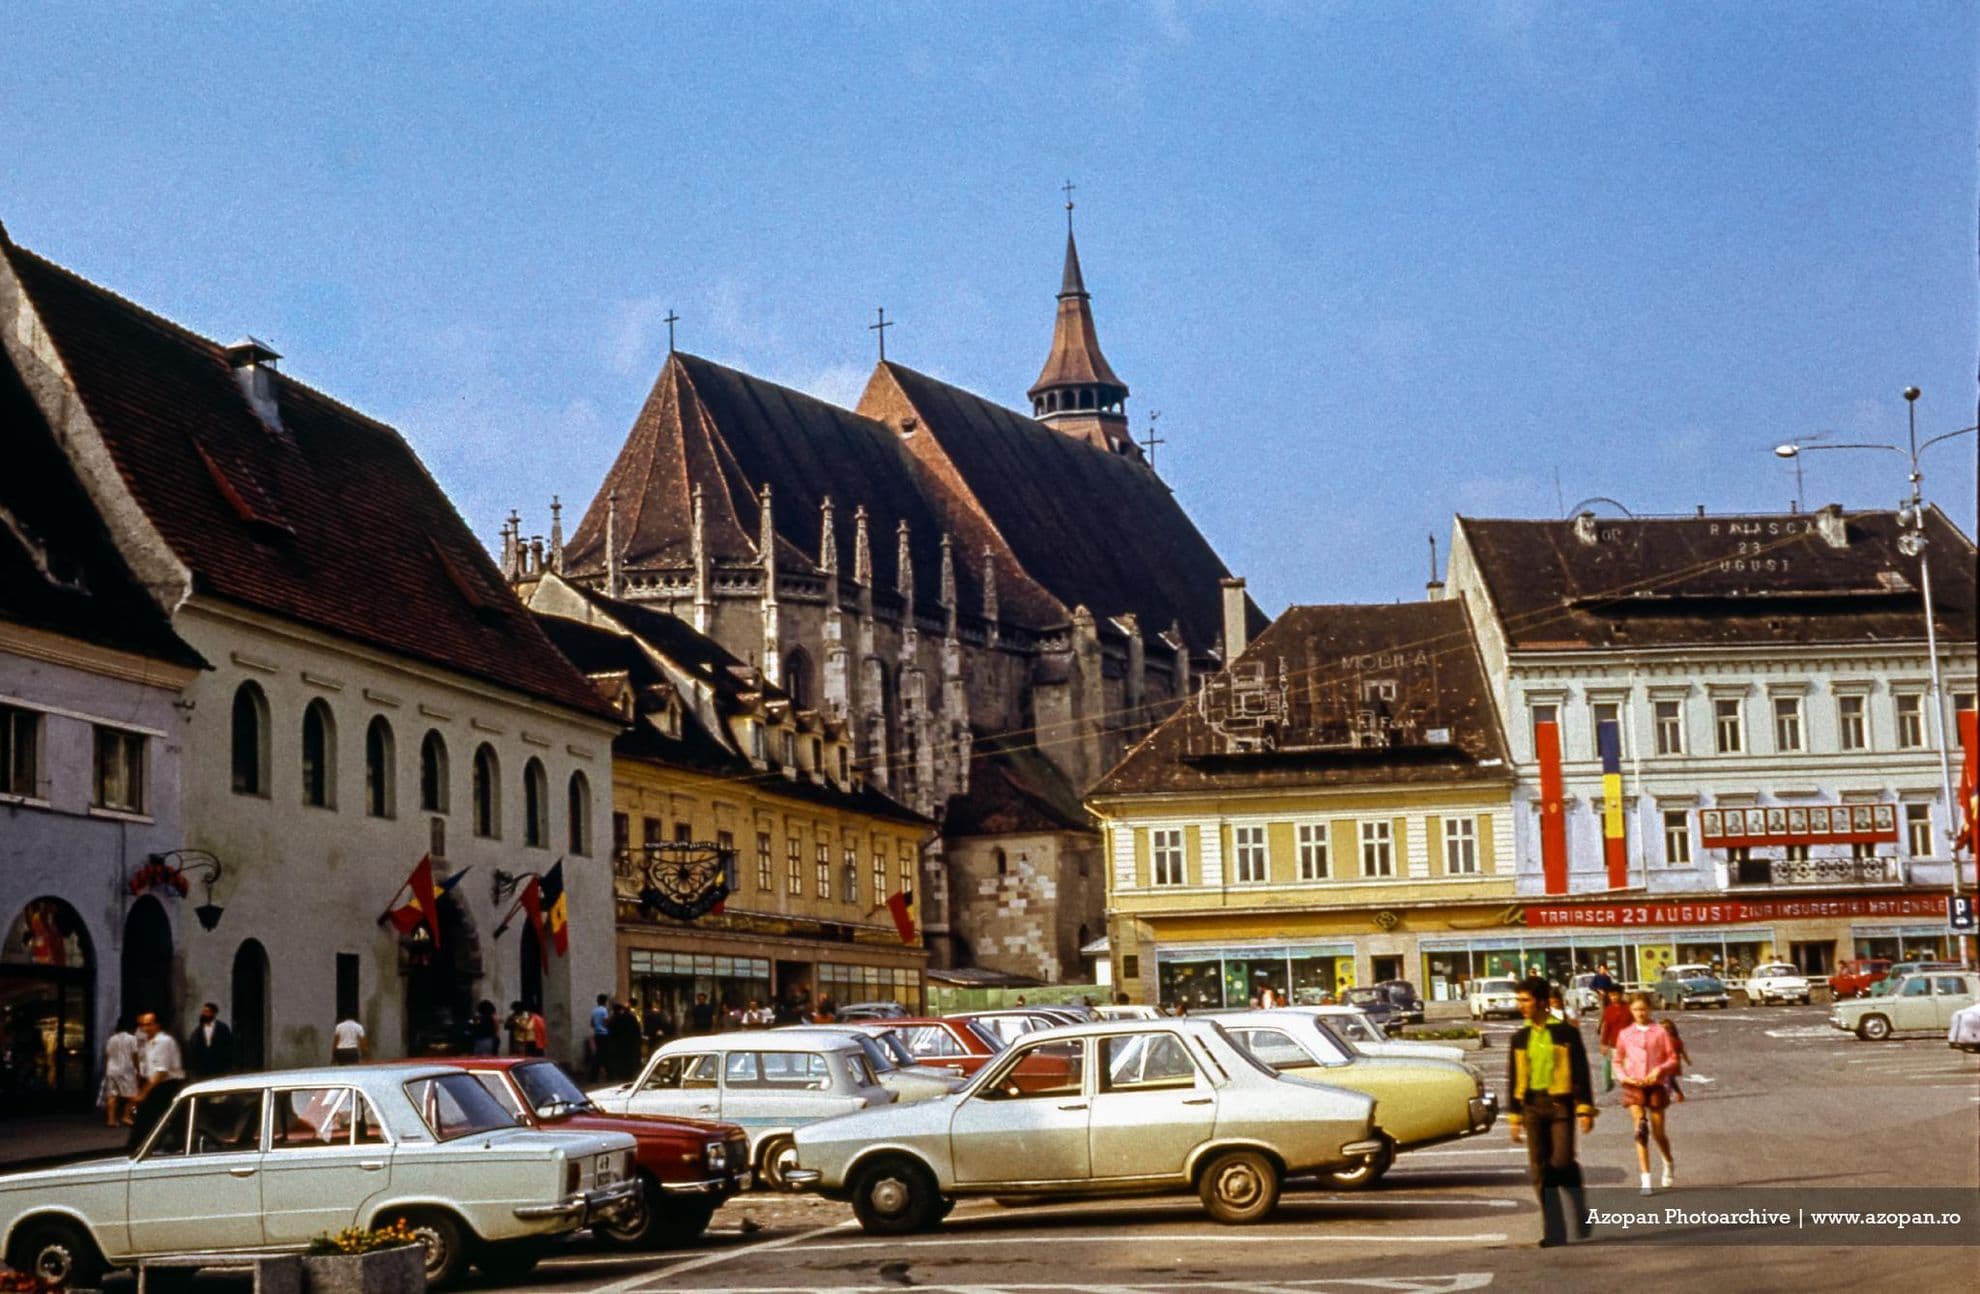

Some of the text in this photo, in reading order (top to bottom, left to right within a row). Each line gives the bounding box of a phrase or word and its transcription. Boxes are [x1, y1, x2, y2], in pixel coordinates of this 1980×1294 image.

[1738, 541, 1761, 556] 23
[1622, 907, 1648, 923] 23
[1655, 905, 1733, 922] AUGUST
[1955, 898, 1966, 916] P
